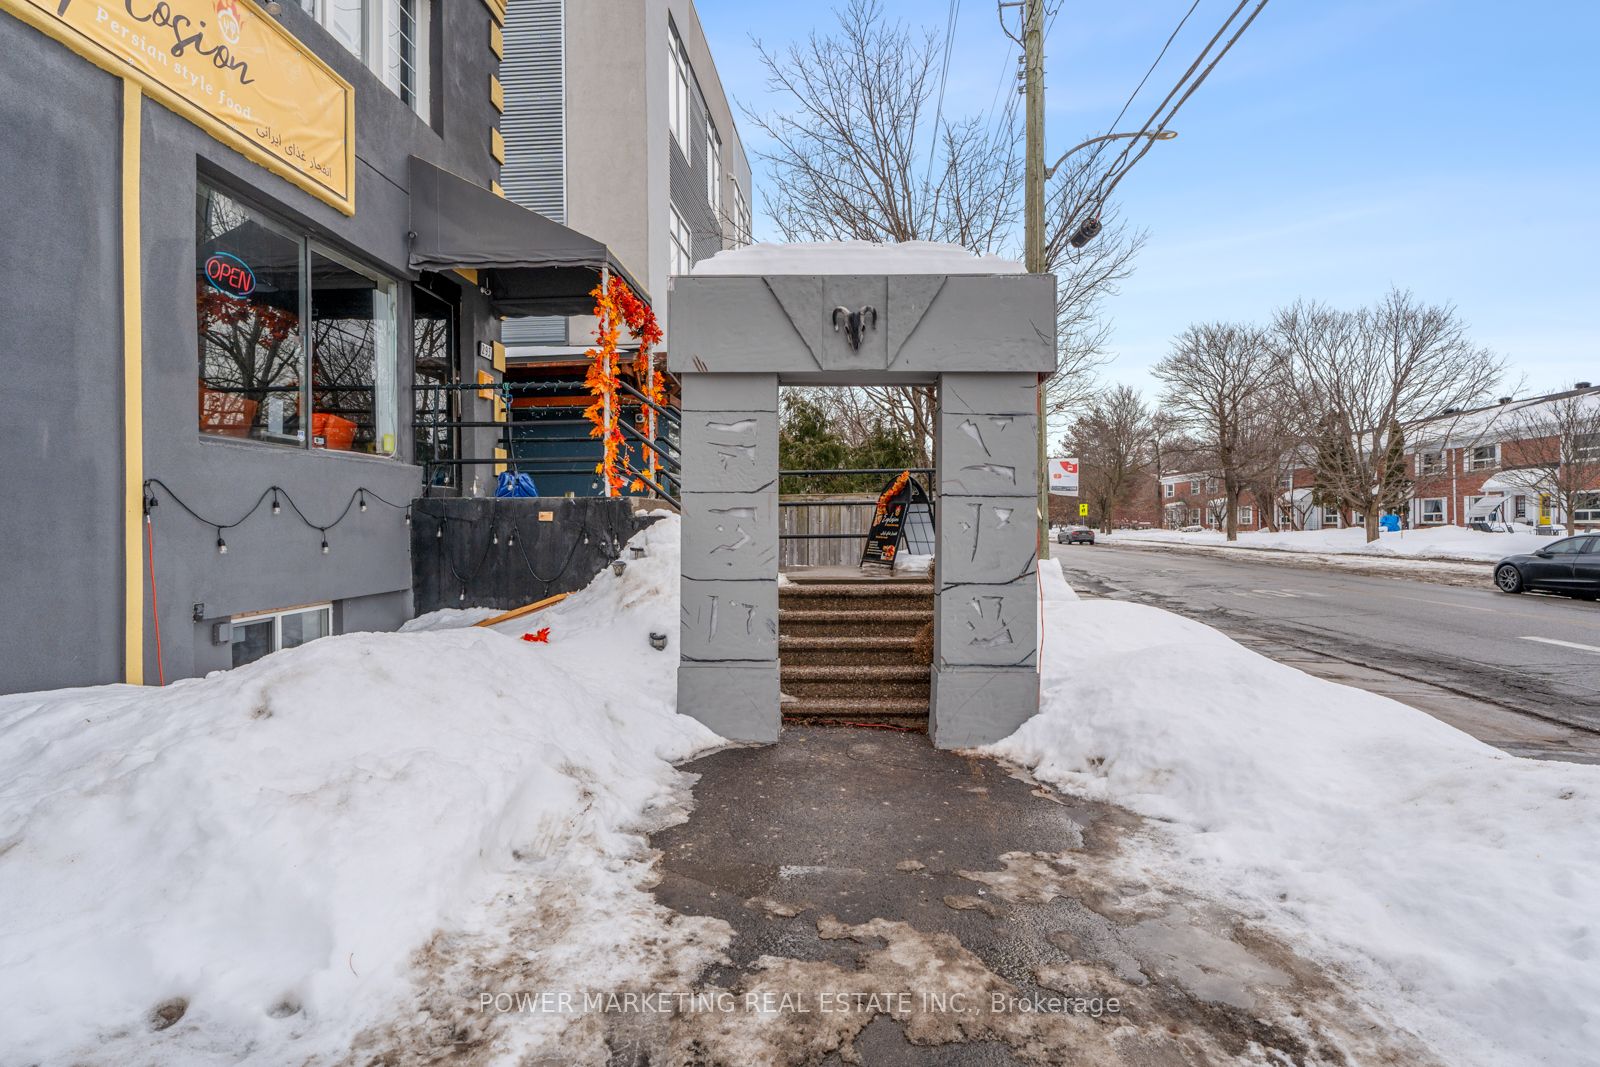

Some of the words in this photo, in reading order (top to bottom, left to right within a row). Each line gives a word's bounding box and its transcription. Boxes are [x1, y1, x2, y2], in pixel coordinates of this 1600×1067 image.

[96, 6, 167, 66] Persian
[174, 62, 213, 95] style
[219, 90, 251, 117] food
[208, 259, 252, 291] OPEN
